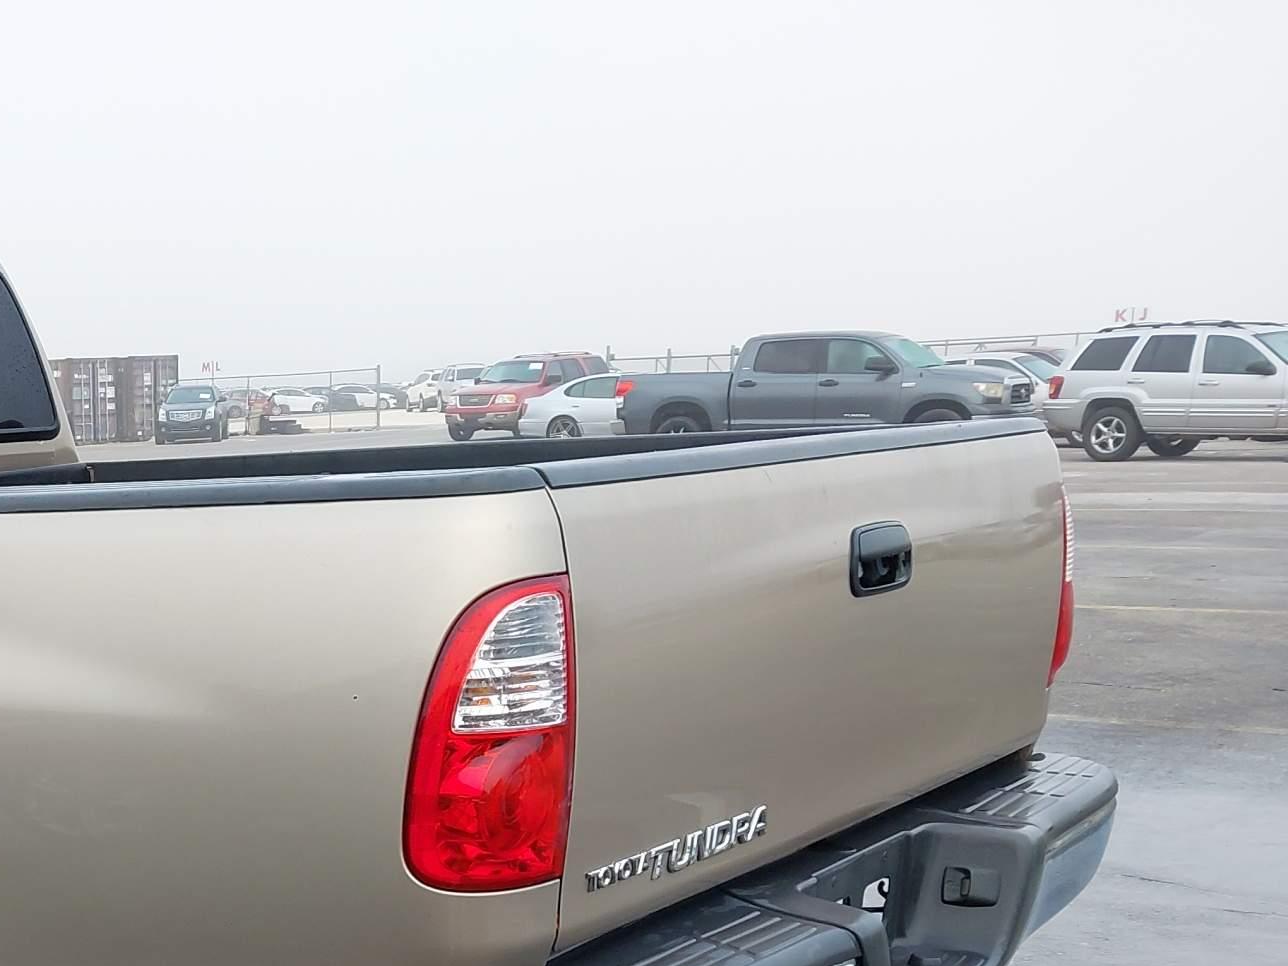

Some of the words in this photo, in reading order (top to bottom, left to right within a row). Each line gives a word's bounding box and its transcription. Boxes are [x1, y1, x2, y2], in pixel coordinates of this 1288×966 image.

[1114, 308, 1127, 322] K
[1139, 307, 1148, 321] J
[201, 361, 211, 373] M
[650, 804, 768, 880] TUNDRA
